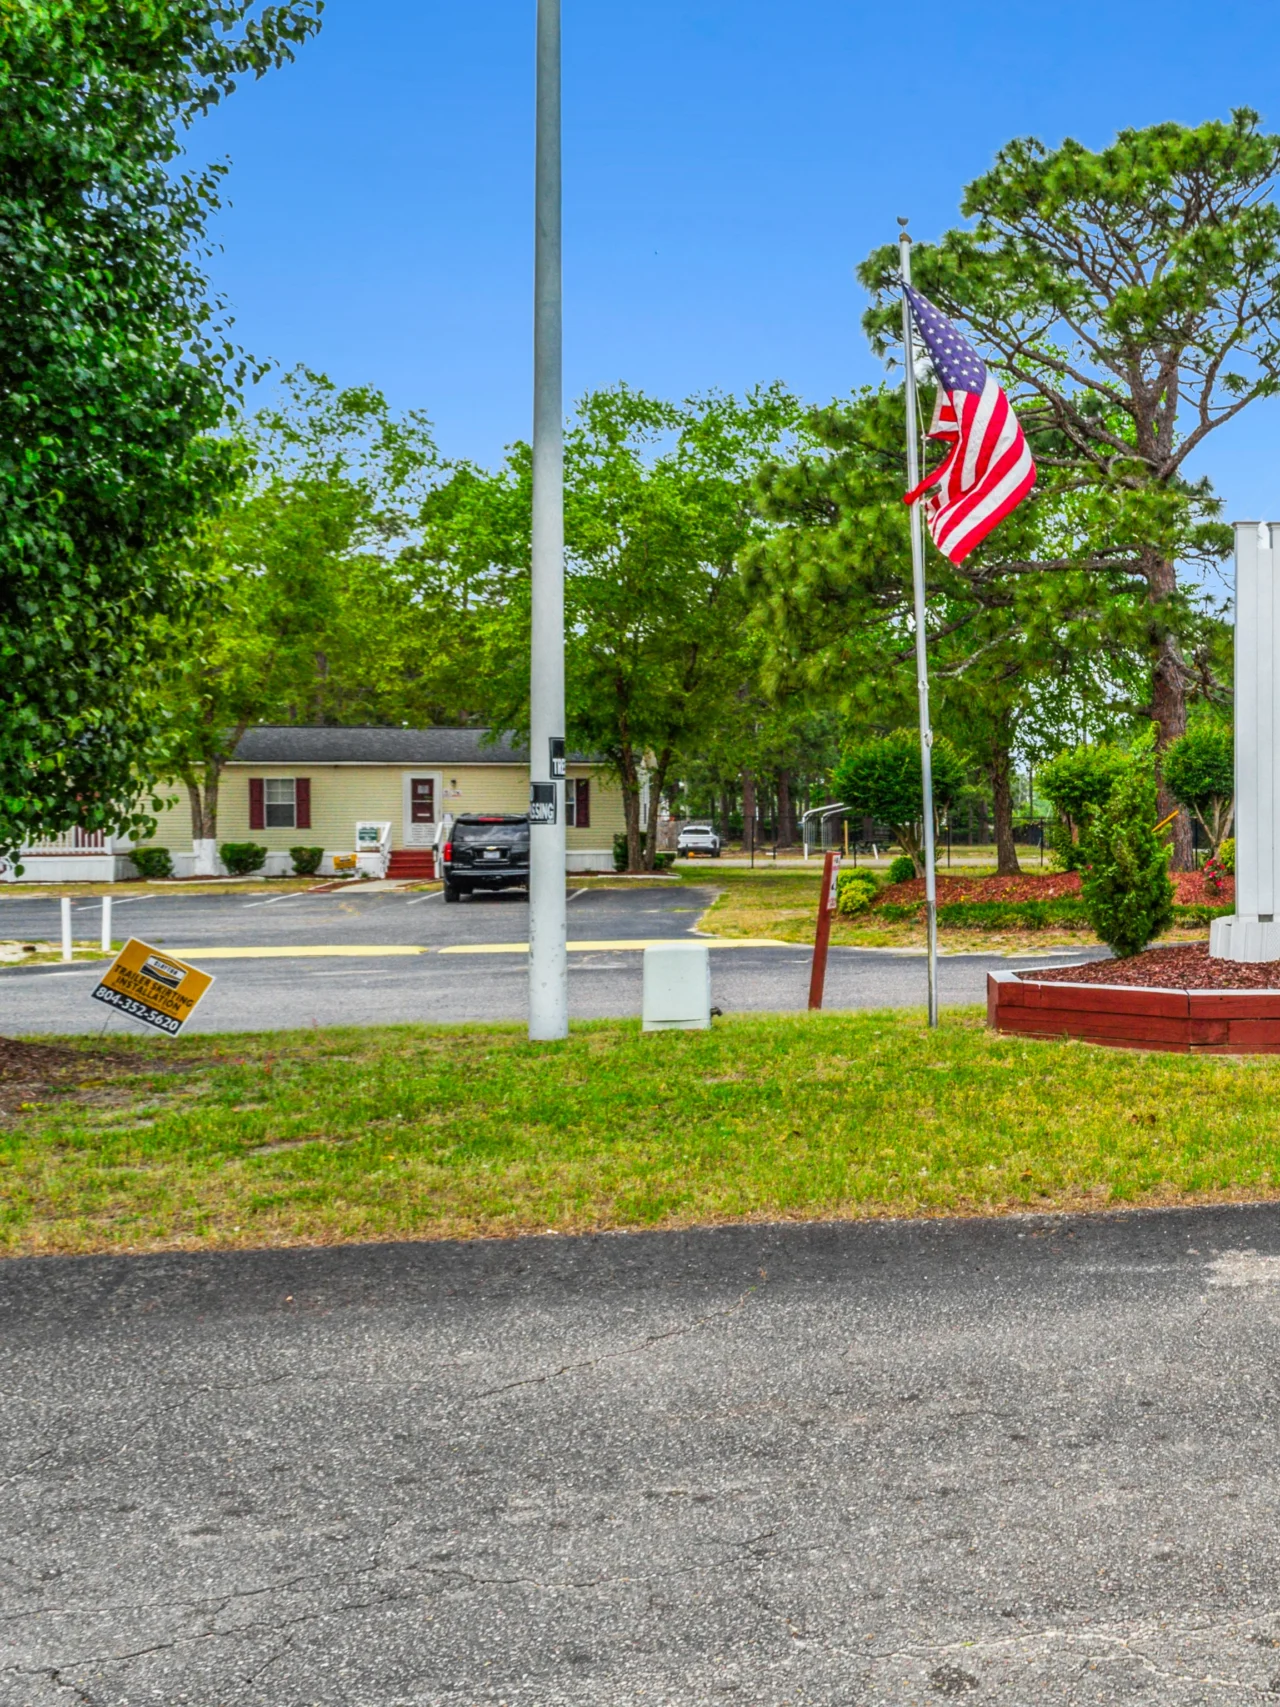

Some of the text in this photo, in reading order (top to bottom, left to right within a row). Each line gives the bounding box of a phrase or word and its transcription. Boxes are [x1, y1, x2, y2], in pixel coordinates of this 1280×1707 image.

[114, 964, 151, 988] TRAILER
[151, 981, 195, 1008] SKIRTING
[115, 976, 182, 1012] INSTALLATION
[95, 985, 179, 1032] 804-352-5620
